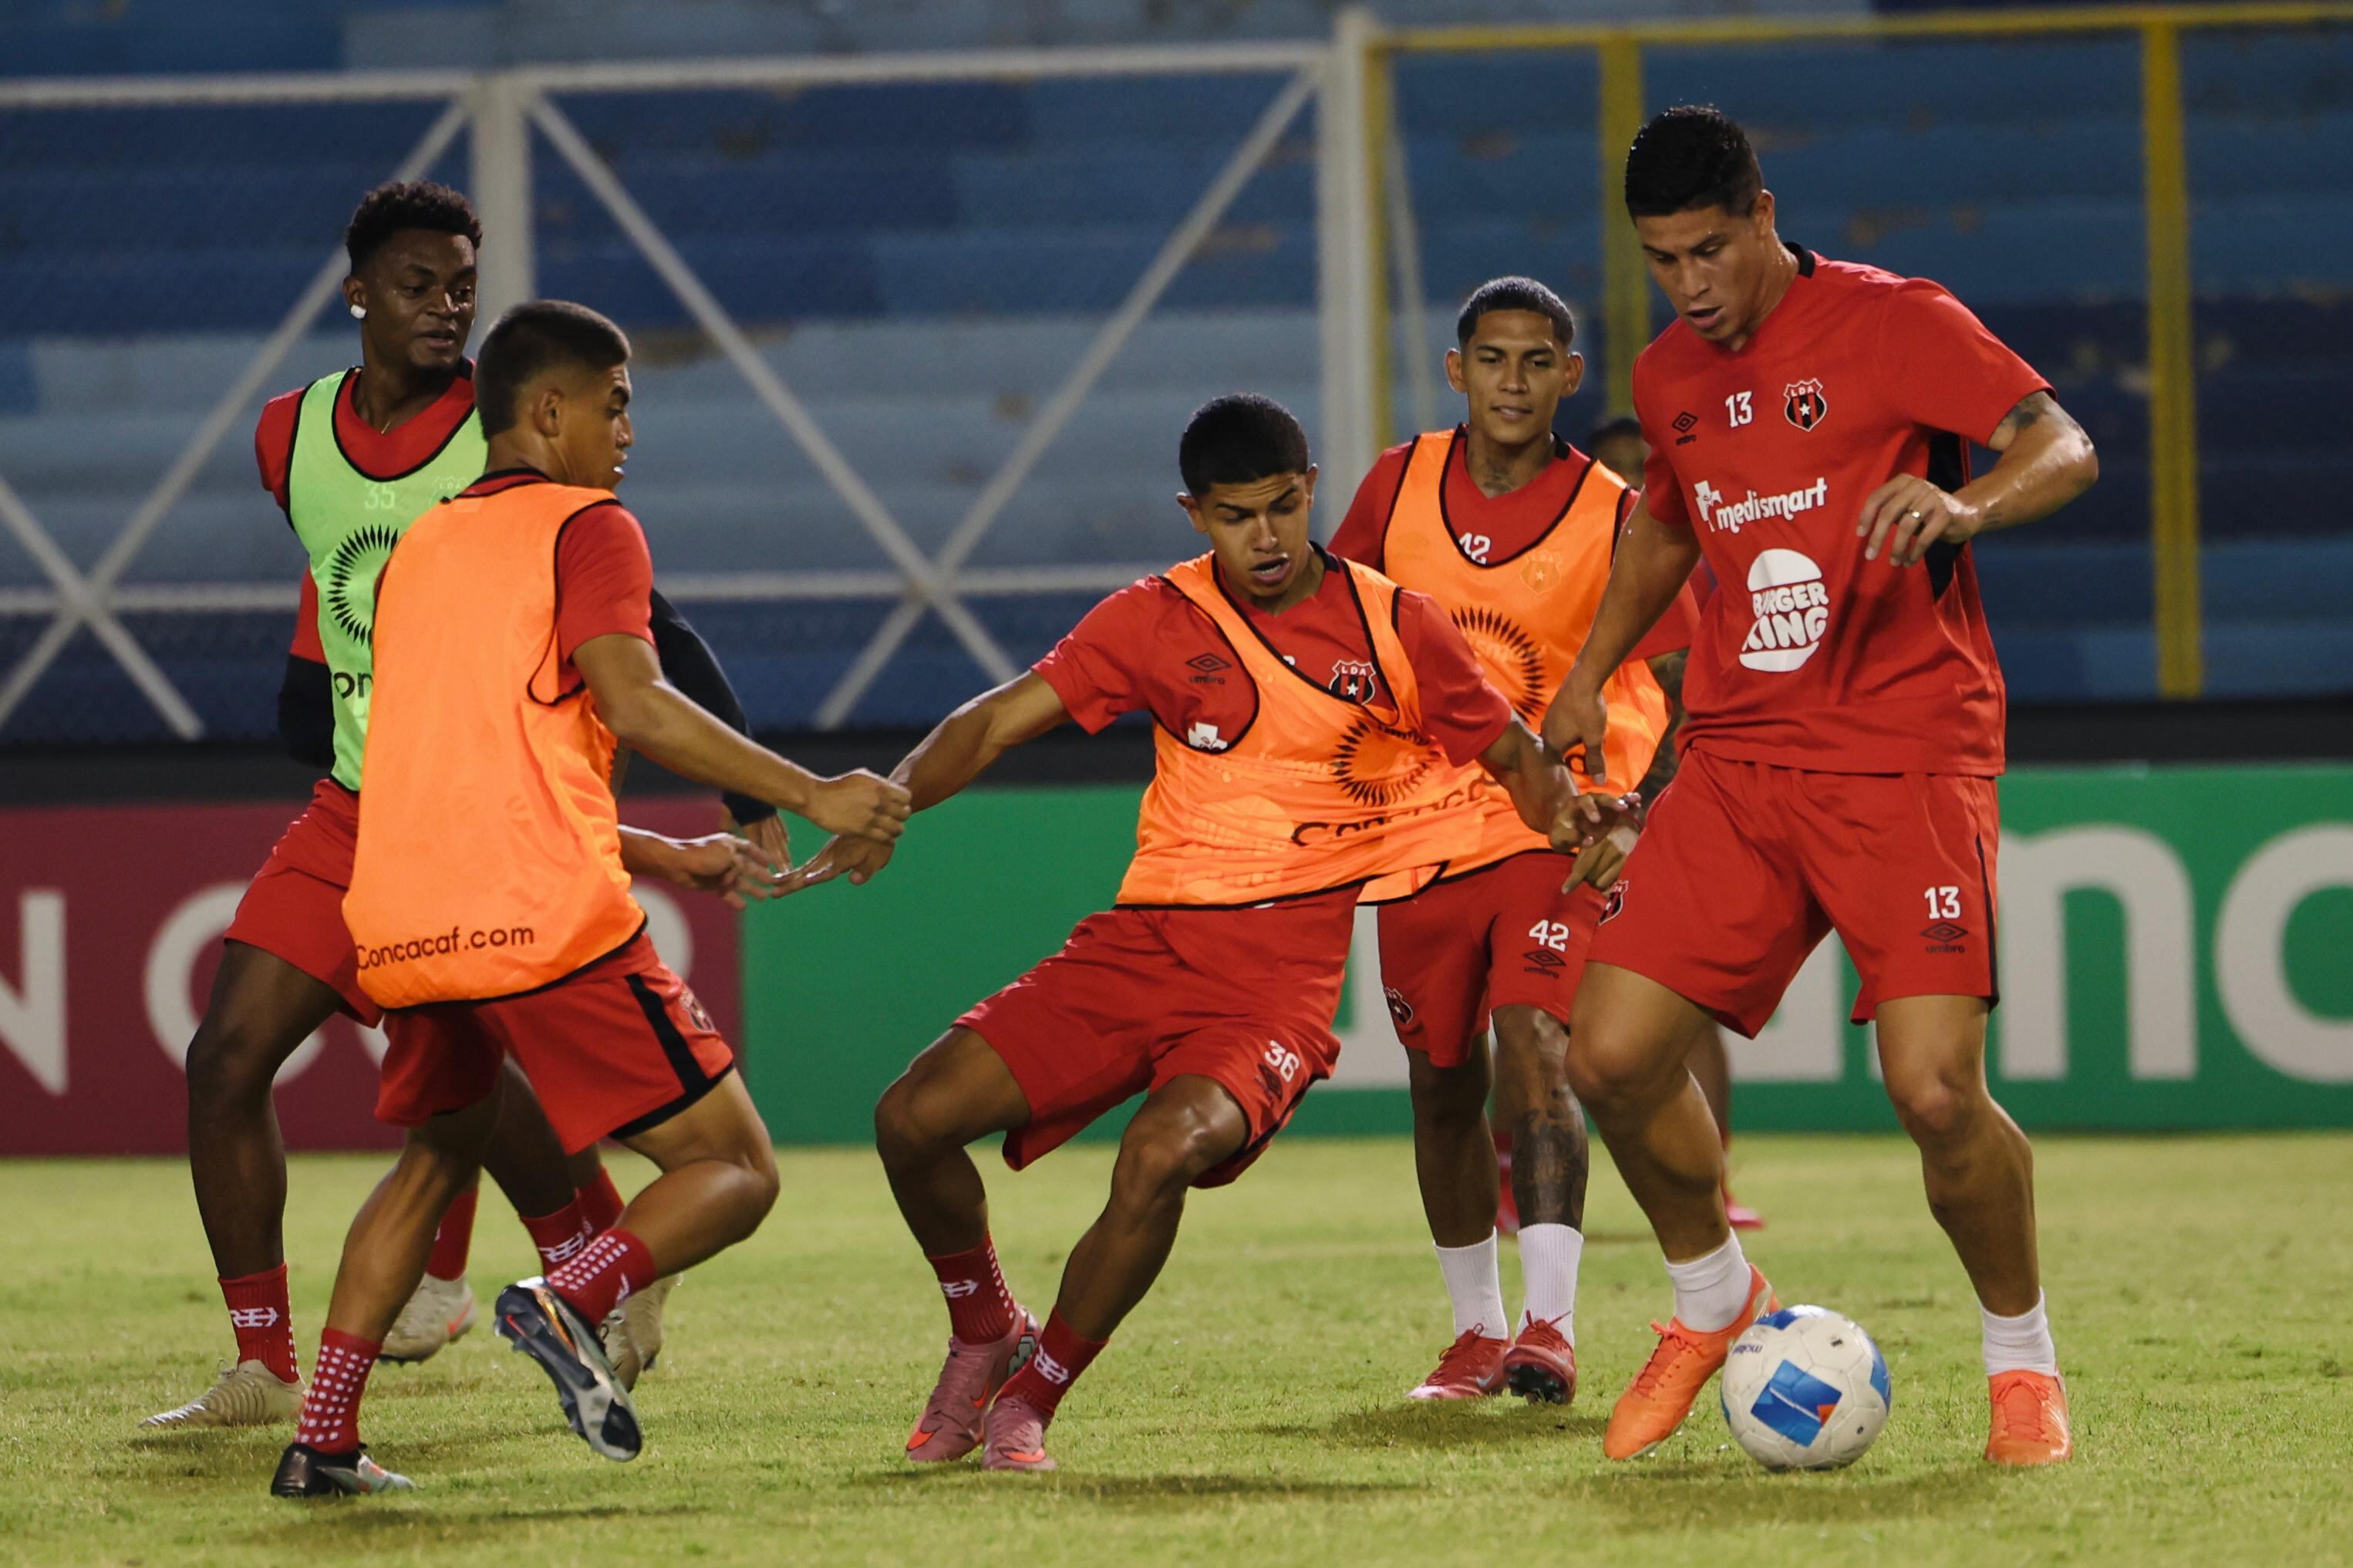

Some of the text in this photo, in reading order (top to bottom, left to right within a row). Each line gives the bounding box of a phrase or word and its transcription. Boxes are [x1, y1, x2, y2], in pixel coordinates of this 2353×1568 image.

[1790, 386, 1814, 397] LDA
[1724, 390, 1753, 428] 13
[365, 481, 396, 510] 35
[1715, 477, 1828, 534] medismart
[1340, 665, 1367, 676] LDA
[1924, 885, 1961, 919] 13
[356, 926, 534, 970] Concacaf.com
[1529, 919, 1569, 952] 42
[1265, 1040, 1300, 1083] 36
